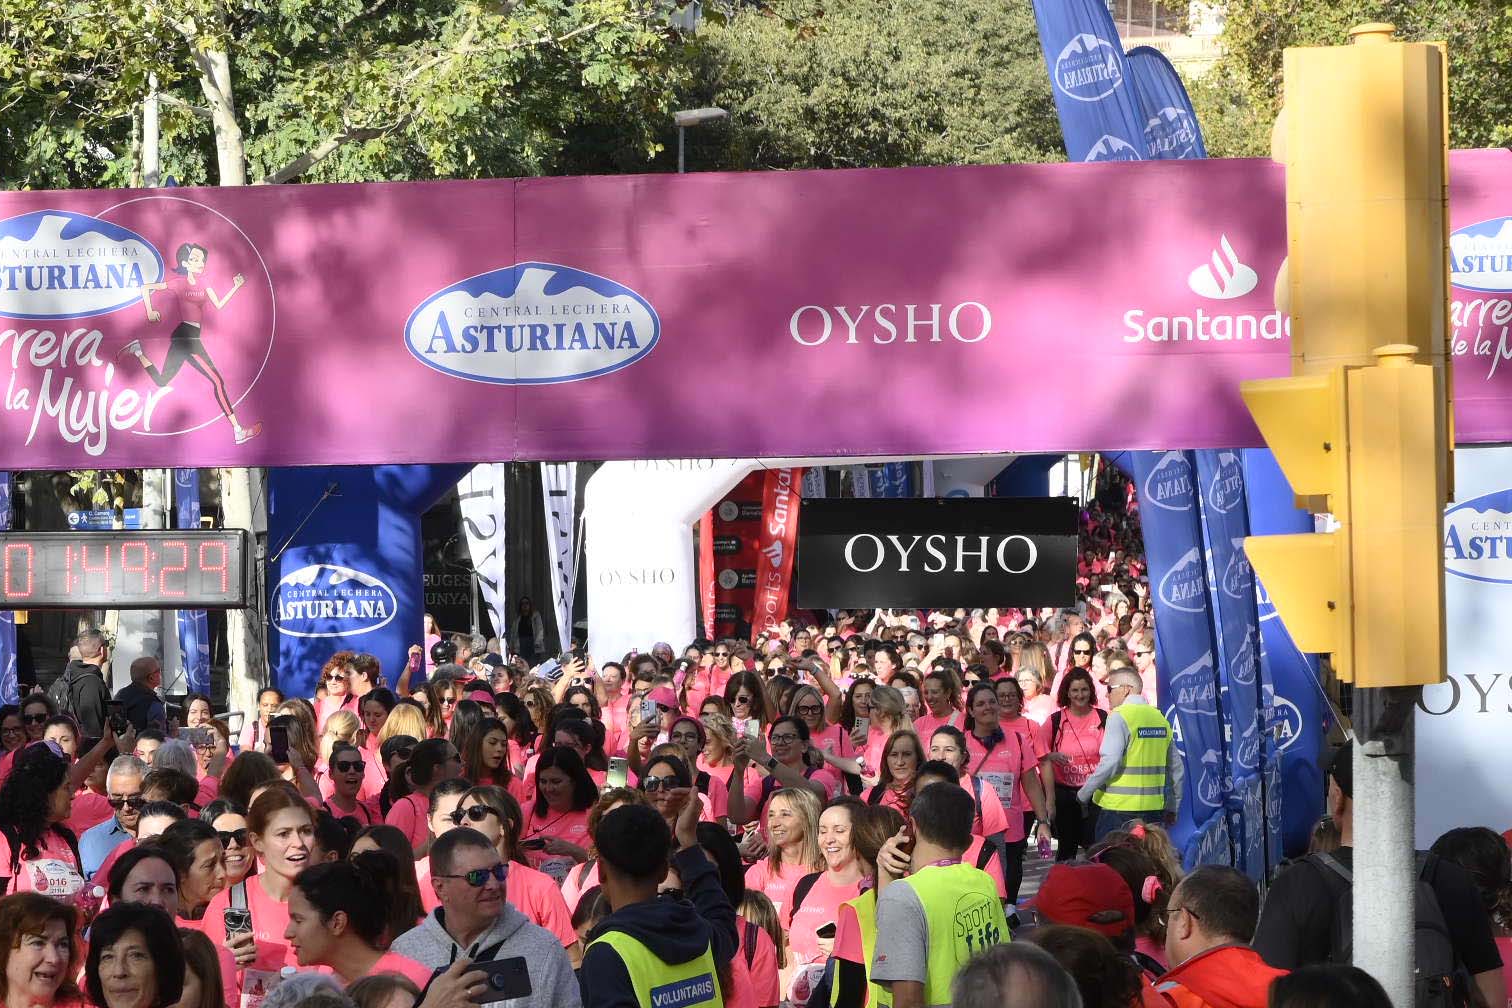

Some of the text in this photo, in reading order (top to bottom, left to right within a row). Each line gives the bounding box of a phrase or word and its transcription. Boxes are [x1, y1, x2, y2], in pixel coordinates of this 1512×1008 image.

[464, 303, 632, 319] CENTRAL LECHERA
[788, 300, 992, 346] OYSHO
[424, 309, 640, 355] ASTURIANA
[1473, 327, 1492, 356] la
[5, 369, 31, 411] la
[24, 362, 174, 457] Mujer
[842, 533, 1039, 575] OYSHO
[599, 567, 676, 587] OYSHO
[287, 589, 383, 598] CENTRAL LECHERA
[274, 595, 388, 621] ASTURIANA
[49, 877, 68, 886] 016
[955, 900, 992, 938] Sport
[652, 980, 714, 1008] VOLUNTARIS
